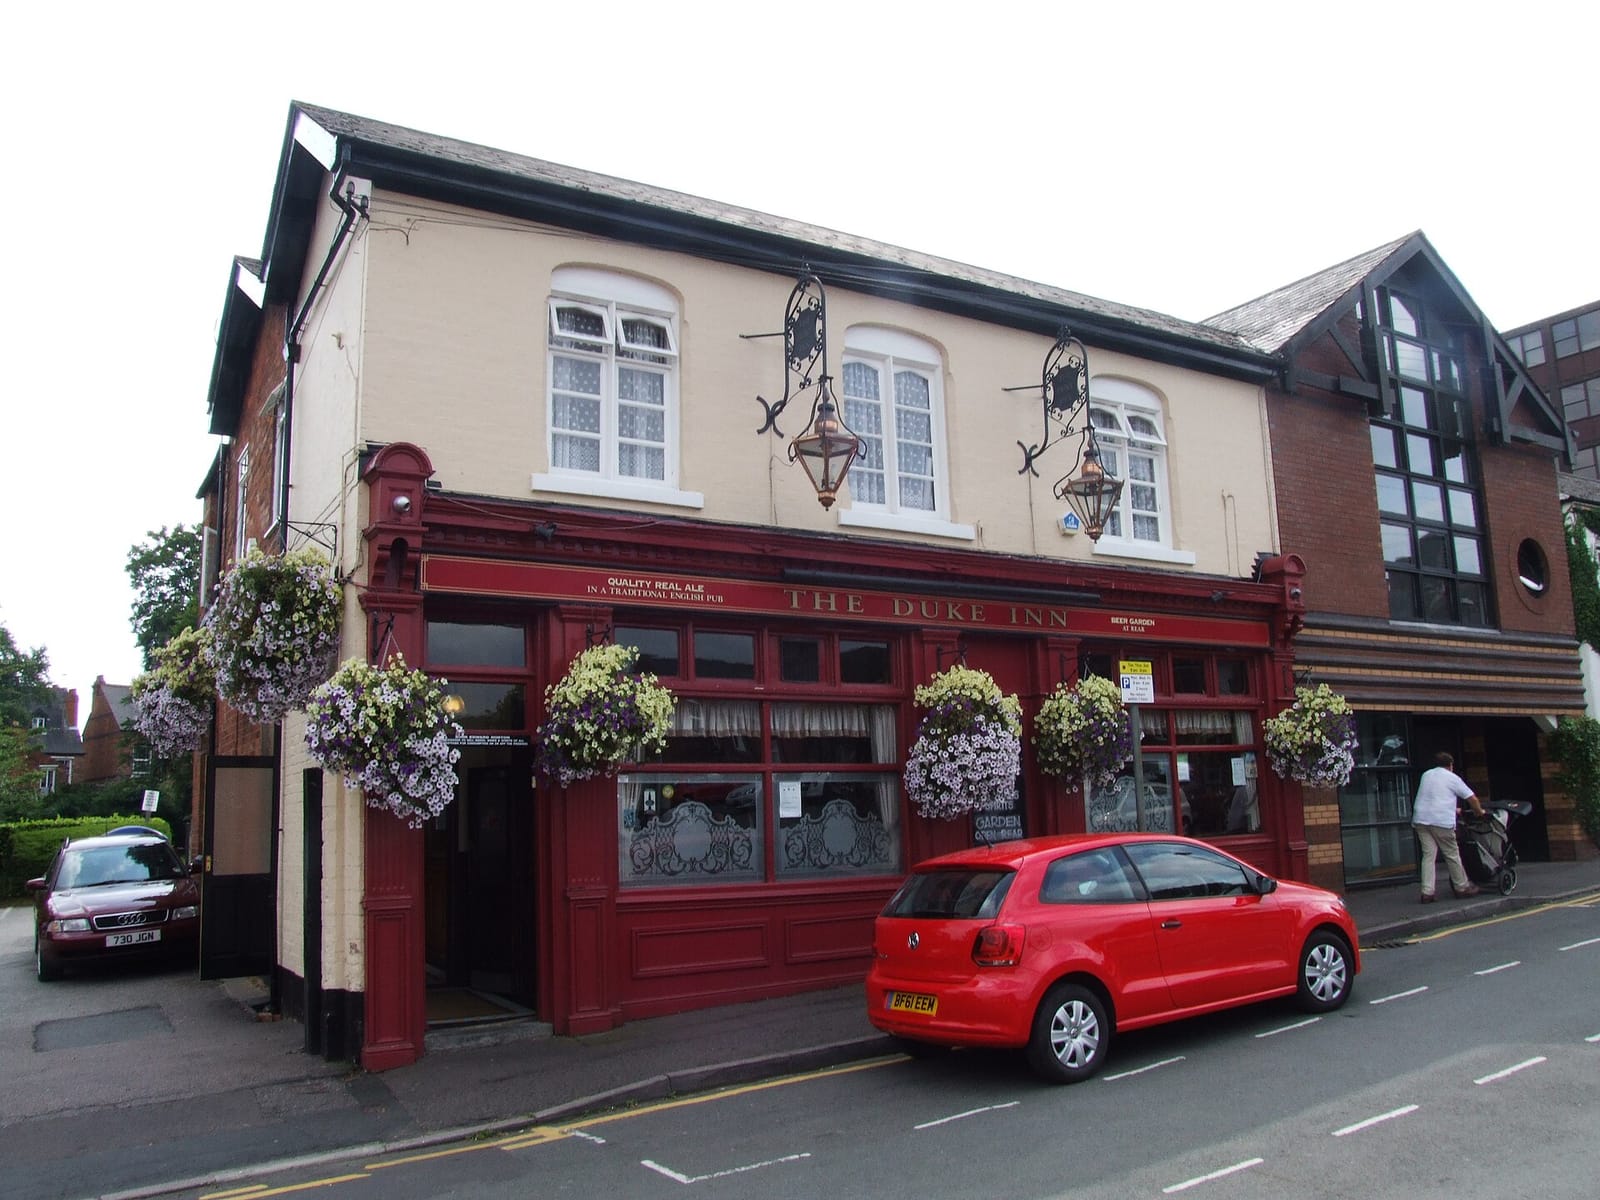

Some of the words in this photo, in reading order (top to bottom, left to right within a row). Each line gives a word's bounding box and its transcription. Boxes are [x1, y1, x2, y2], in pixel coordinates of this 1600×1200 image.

[608, 577, 651, 588] QUALITY
[655, 581, 681, 591] REAL
[685, 584, 704, 592] ALE
[587, 585, 597, 593] IN
[609, 587, 667, 599] TRADITIONAL
[670, 592, 703, 601] ENGLISH
[707, 595, 723, 603] PUB
[783, 588, 864, 613] THE
[892, 597, 986, 623] DUKE
[1009, 607, 1067, 628] INN
[1111, 616, 1128, 624] BEER
[1129, 618, 1155, 626] GARDEN
[976, 815, 1021, 829] GARDEN
[113, 935, 133, 945] 730
[135, 931, 154, 943] JGN
[894, 993, 914, 1009] BF61
